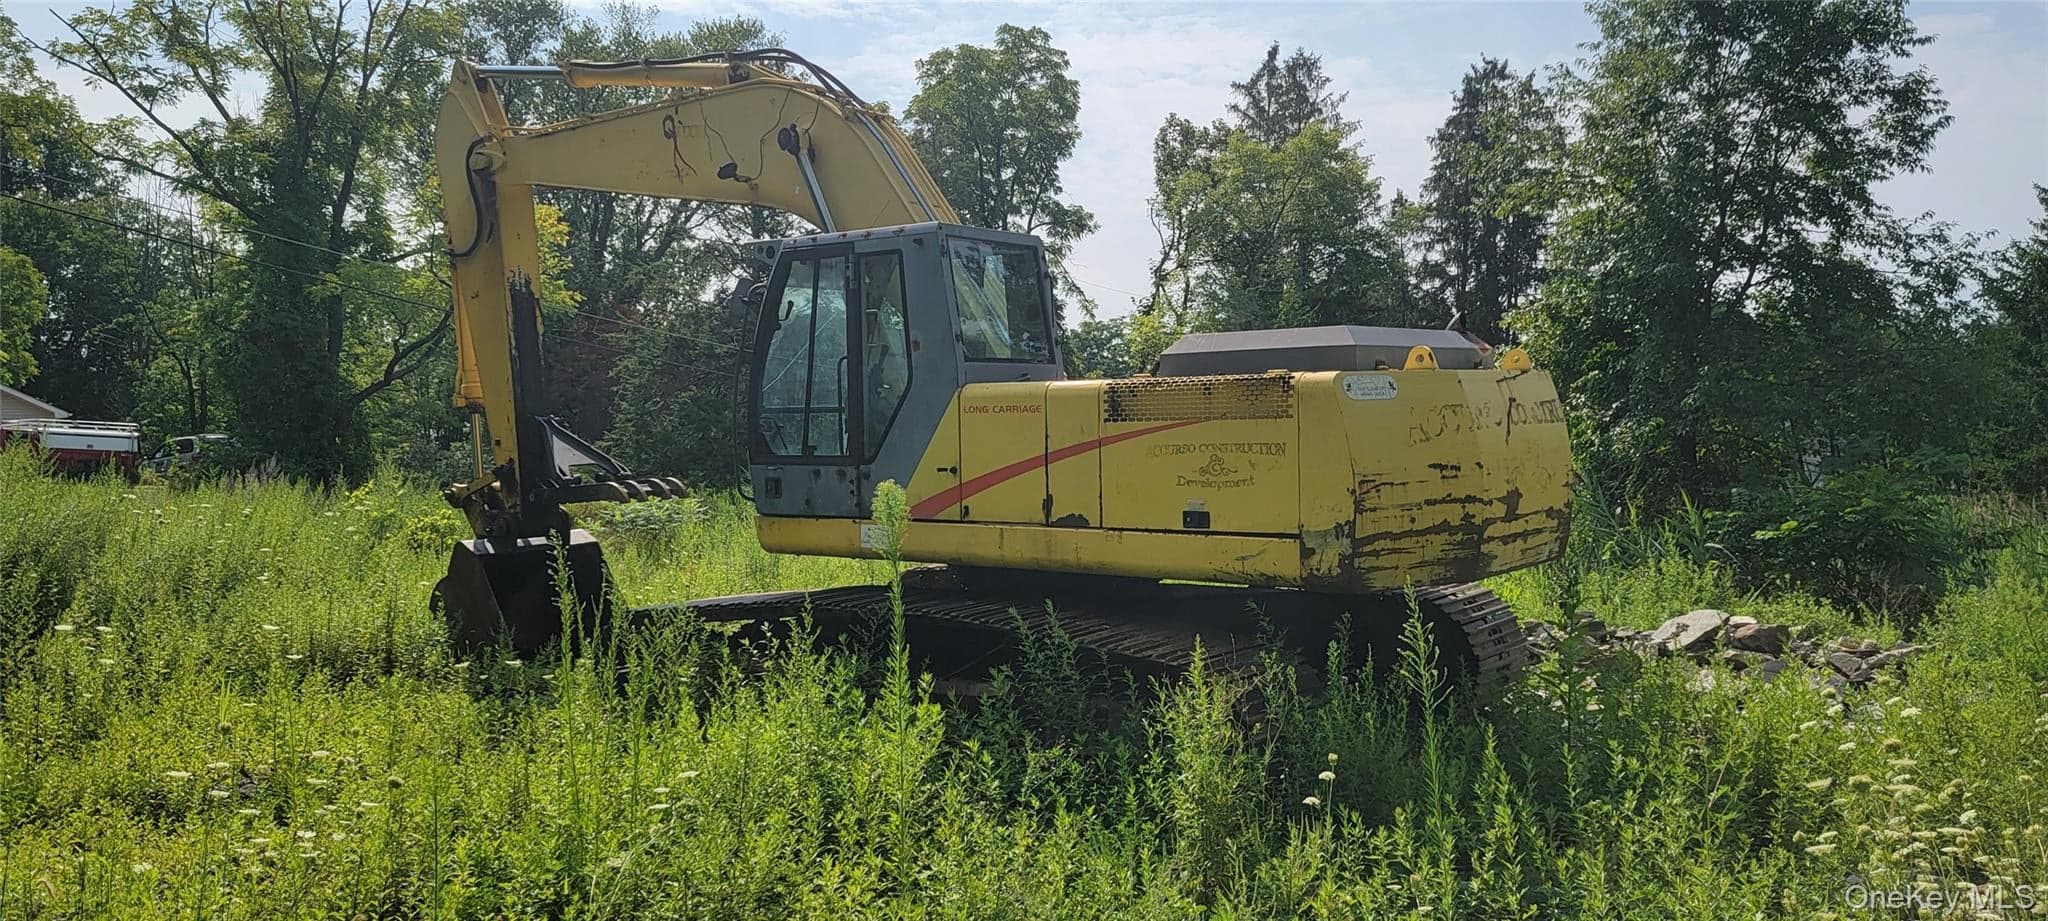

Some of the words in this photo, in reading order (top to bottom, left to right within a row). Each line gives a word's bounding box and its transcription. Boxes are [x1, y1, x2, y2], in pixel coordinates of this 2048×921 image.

[963, 405, 989, 414] LONG
[992, 405, 1042, 414] CARRIAGE
[1199, 442, 1287, 457] CONSTRUCTION
[1176, 475, 1256, 492] Development
